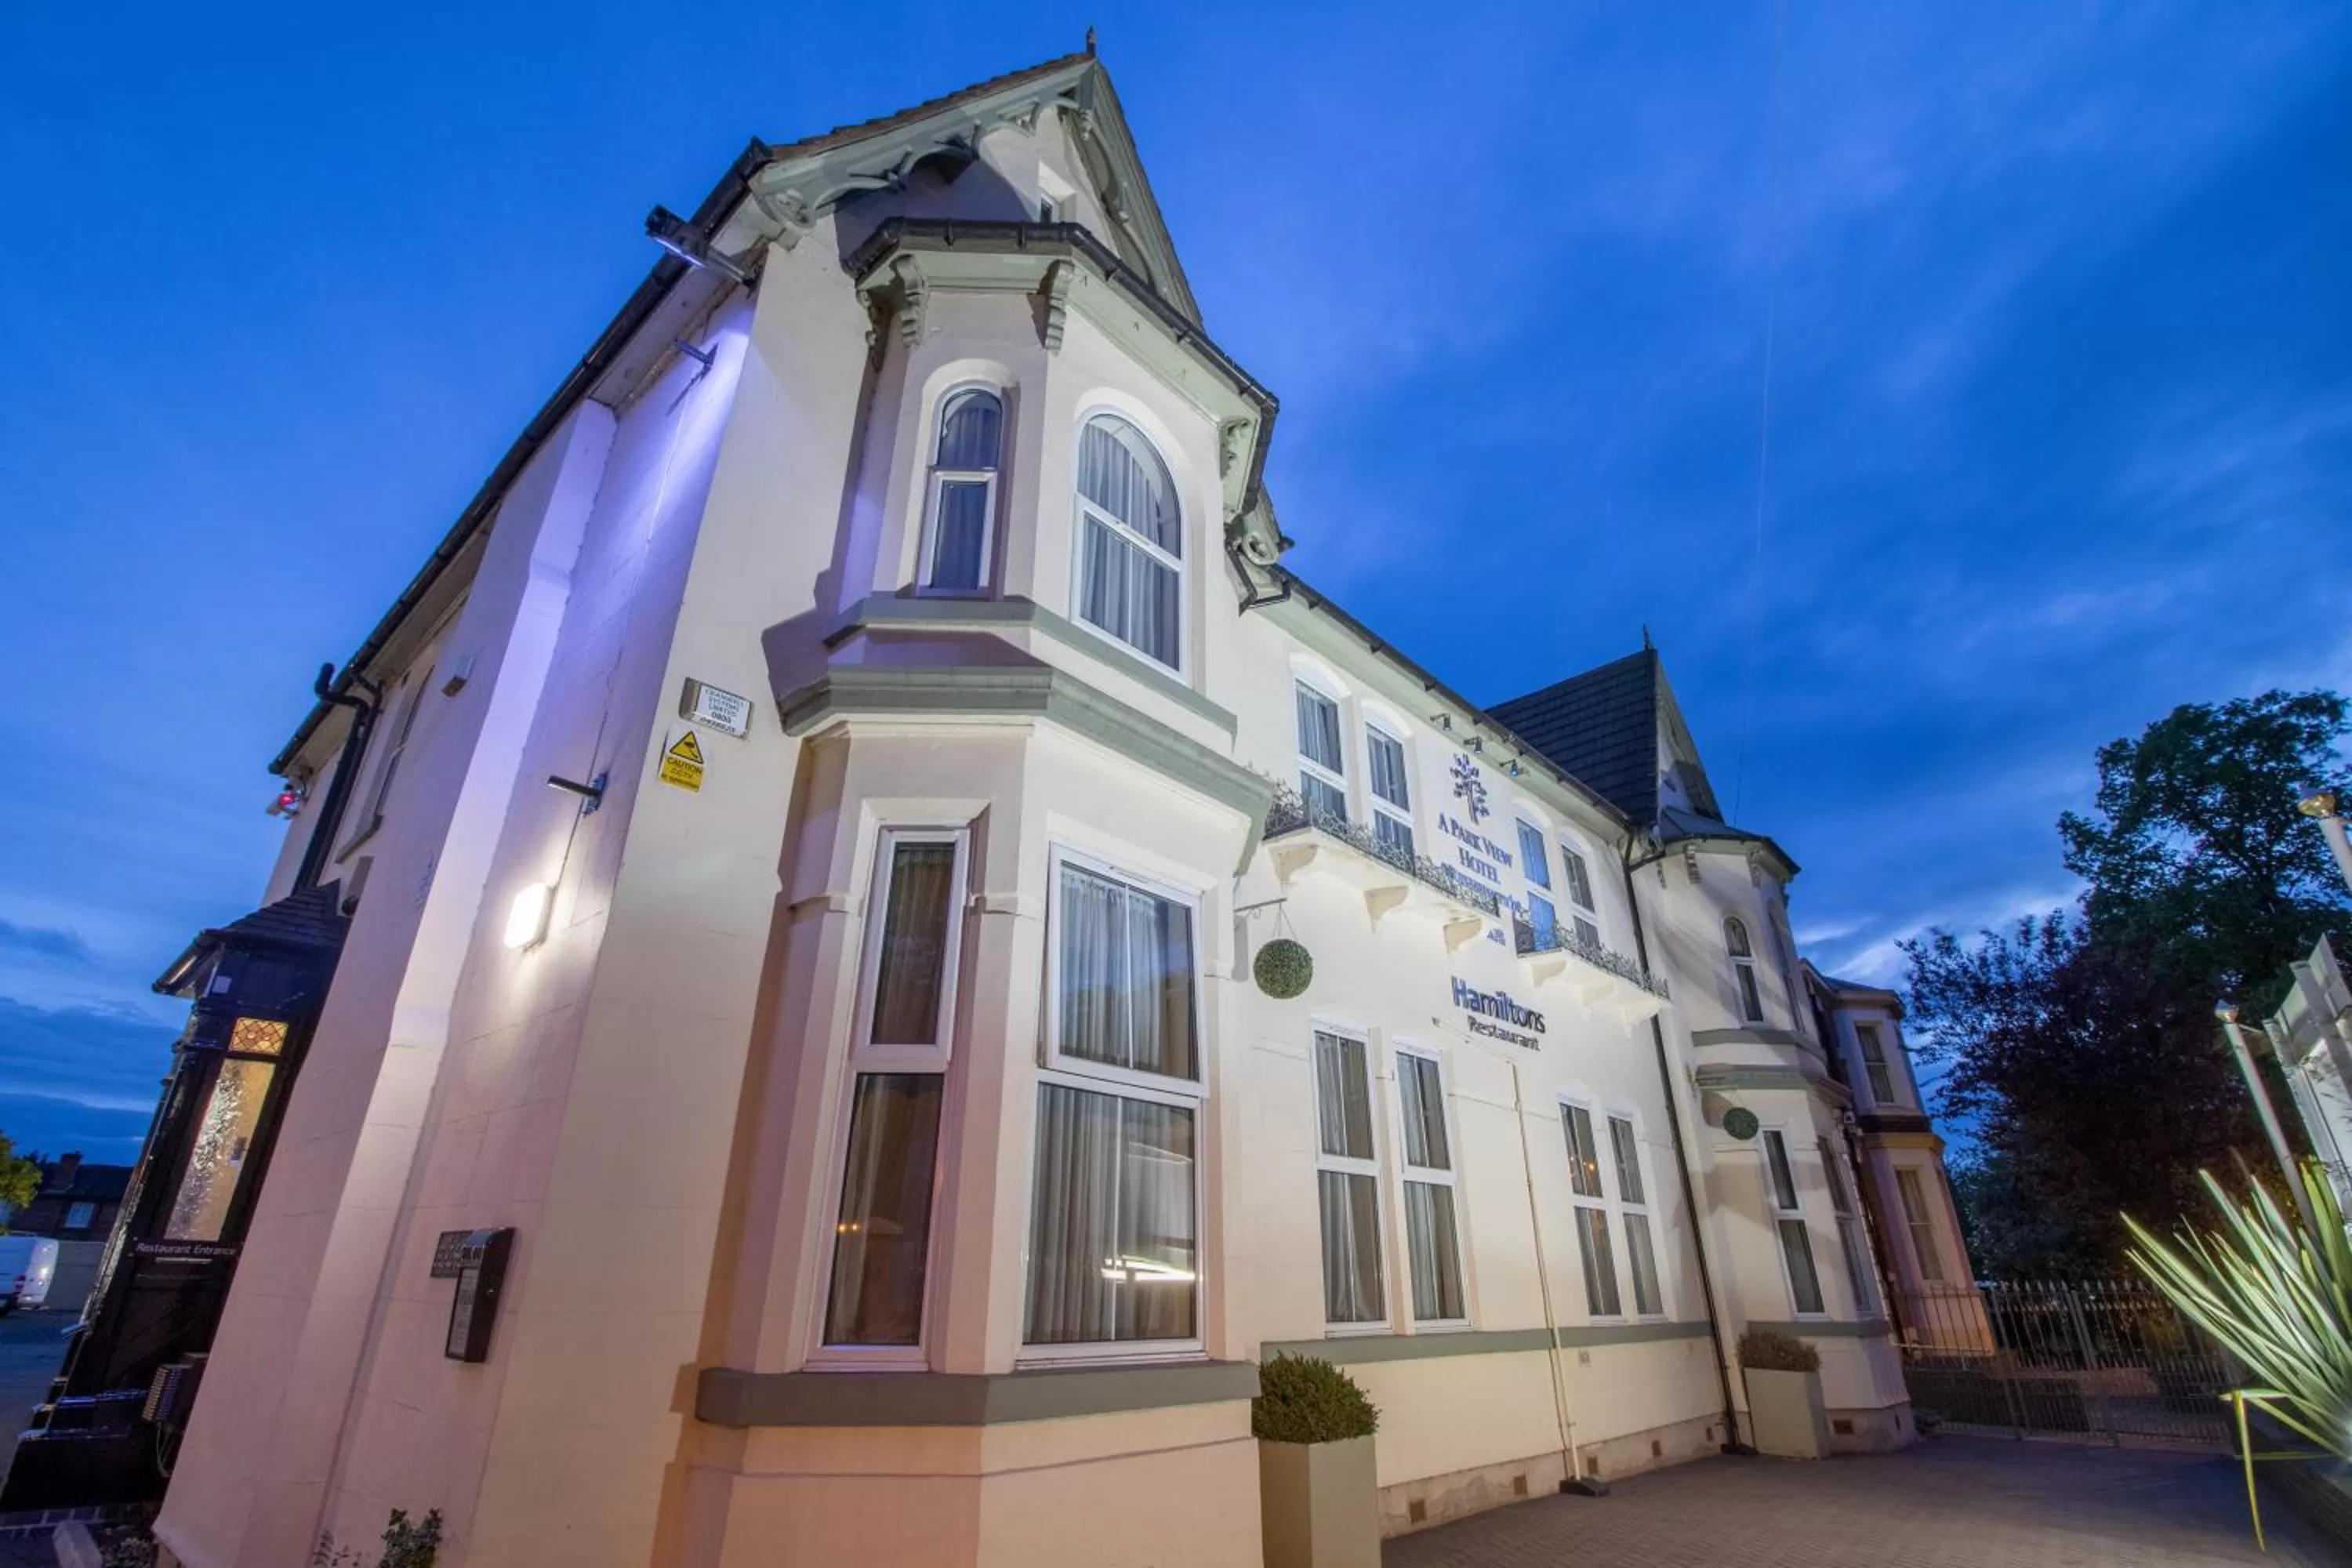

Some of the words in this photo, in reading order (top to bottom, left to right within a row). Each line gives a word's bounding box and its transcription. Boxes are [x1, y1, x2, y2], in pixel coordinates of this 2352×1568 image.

[667, 756, 703, 775] CAUTION
[1437, 811, 1449, 834] A
[1457, 844, 1501, 885] HOTEL
[1450, 975, 1546, 1034] Hamiltons
[1467, 1014, 1541, 1052] Restaurant
[136, 1242, 191, 1254] Restaurant
[192, 1243, 236, 1255] Entrance
